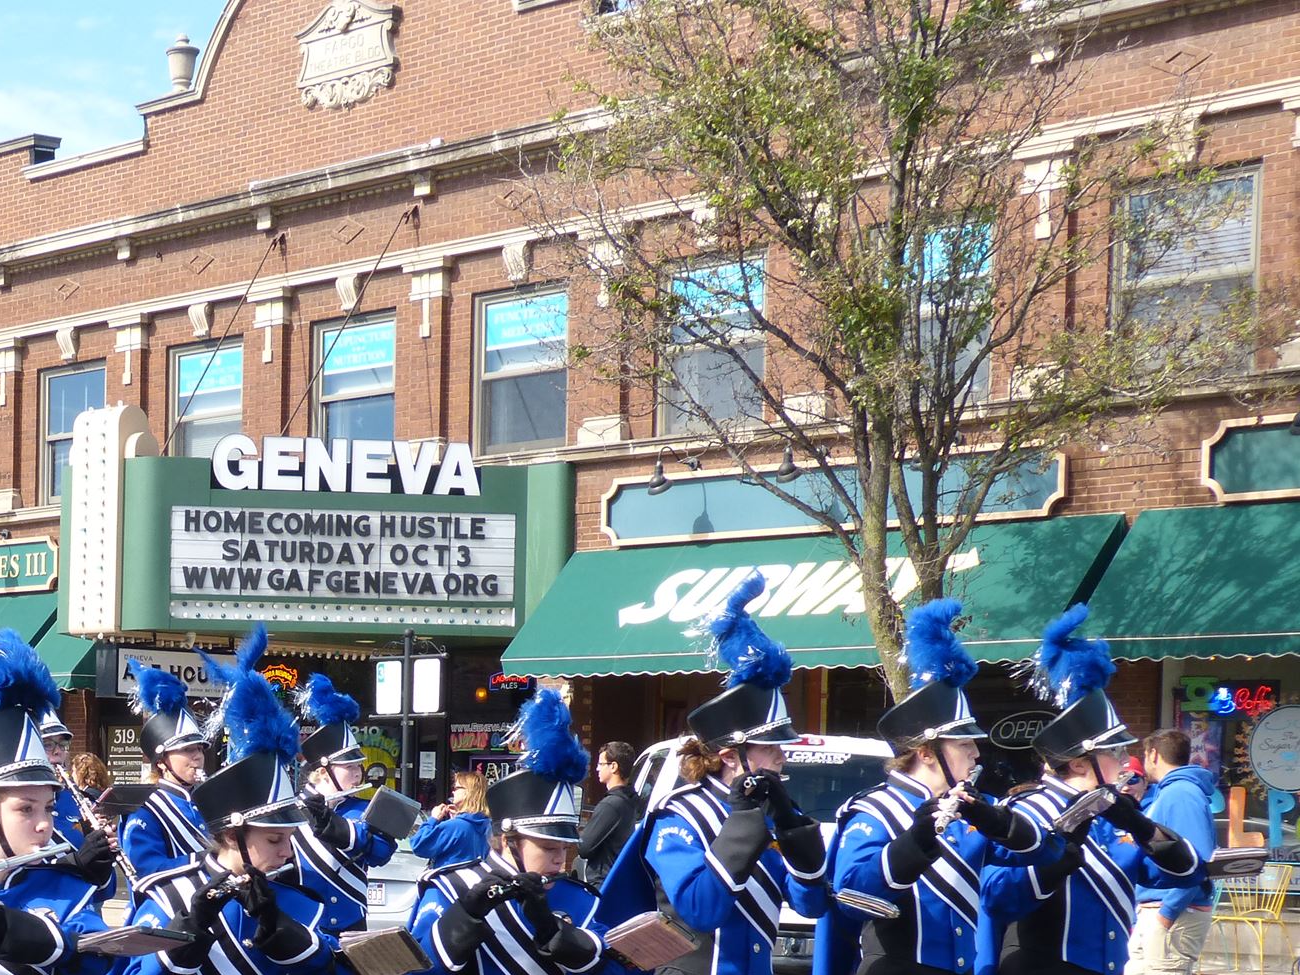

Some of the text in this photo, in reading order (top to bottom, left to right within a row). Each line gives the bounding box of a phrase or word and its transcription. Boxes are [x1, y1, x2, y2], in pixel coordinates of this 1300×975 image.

[325, 34, 365, 55] FARGO
[310, 45, 381, 73] THEATRE BLDG
[212, 433, 481, 496] GENEVA
[184, 509, 486, 540] HOMECOMING HUSTLE
[25, 552, 47, 577] III
[222, 539, 471, 567] SATURDAY OCT 3
[267, 568, 437, 595] GAFGENEVA
[443, 573, 498, 597] ORG
[123, 653, 154, 662] GENEVA
[500, 681, 518, 690] ALES
[113, 728, 135, 744] 319
